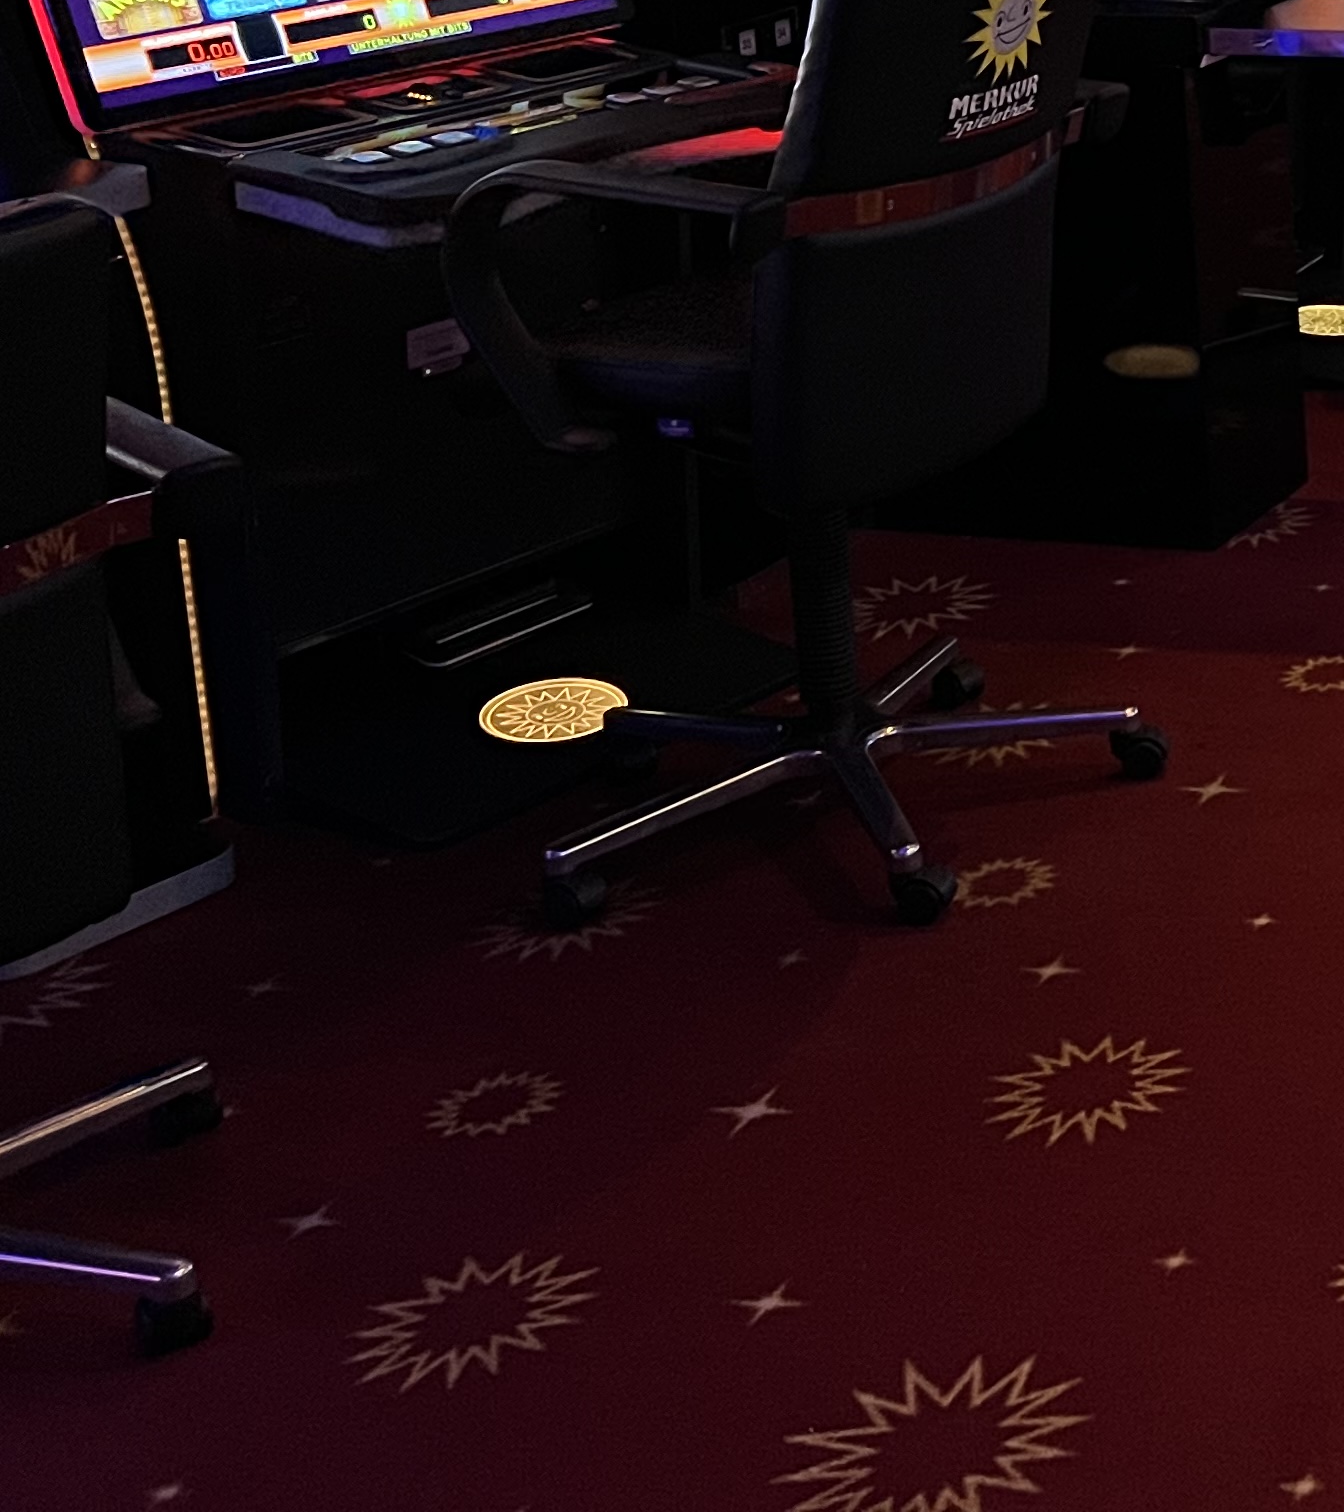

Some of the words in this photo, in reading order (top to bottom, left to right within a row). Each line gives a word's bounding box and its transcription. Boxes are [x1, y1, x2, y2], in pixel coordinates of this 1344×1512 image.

[362, 14, 377, 30] 0
[187, 41, 235, 63] 0.00
[948, 74, 1039, 120] MERKUR
[946, 95, 1037, 139] Spielothek
